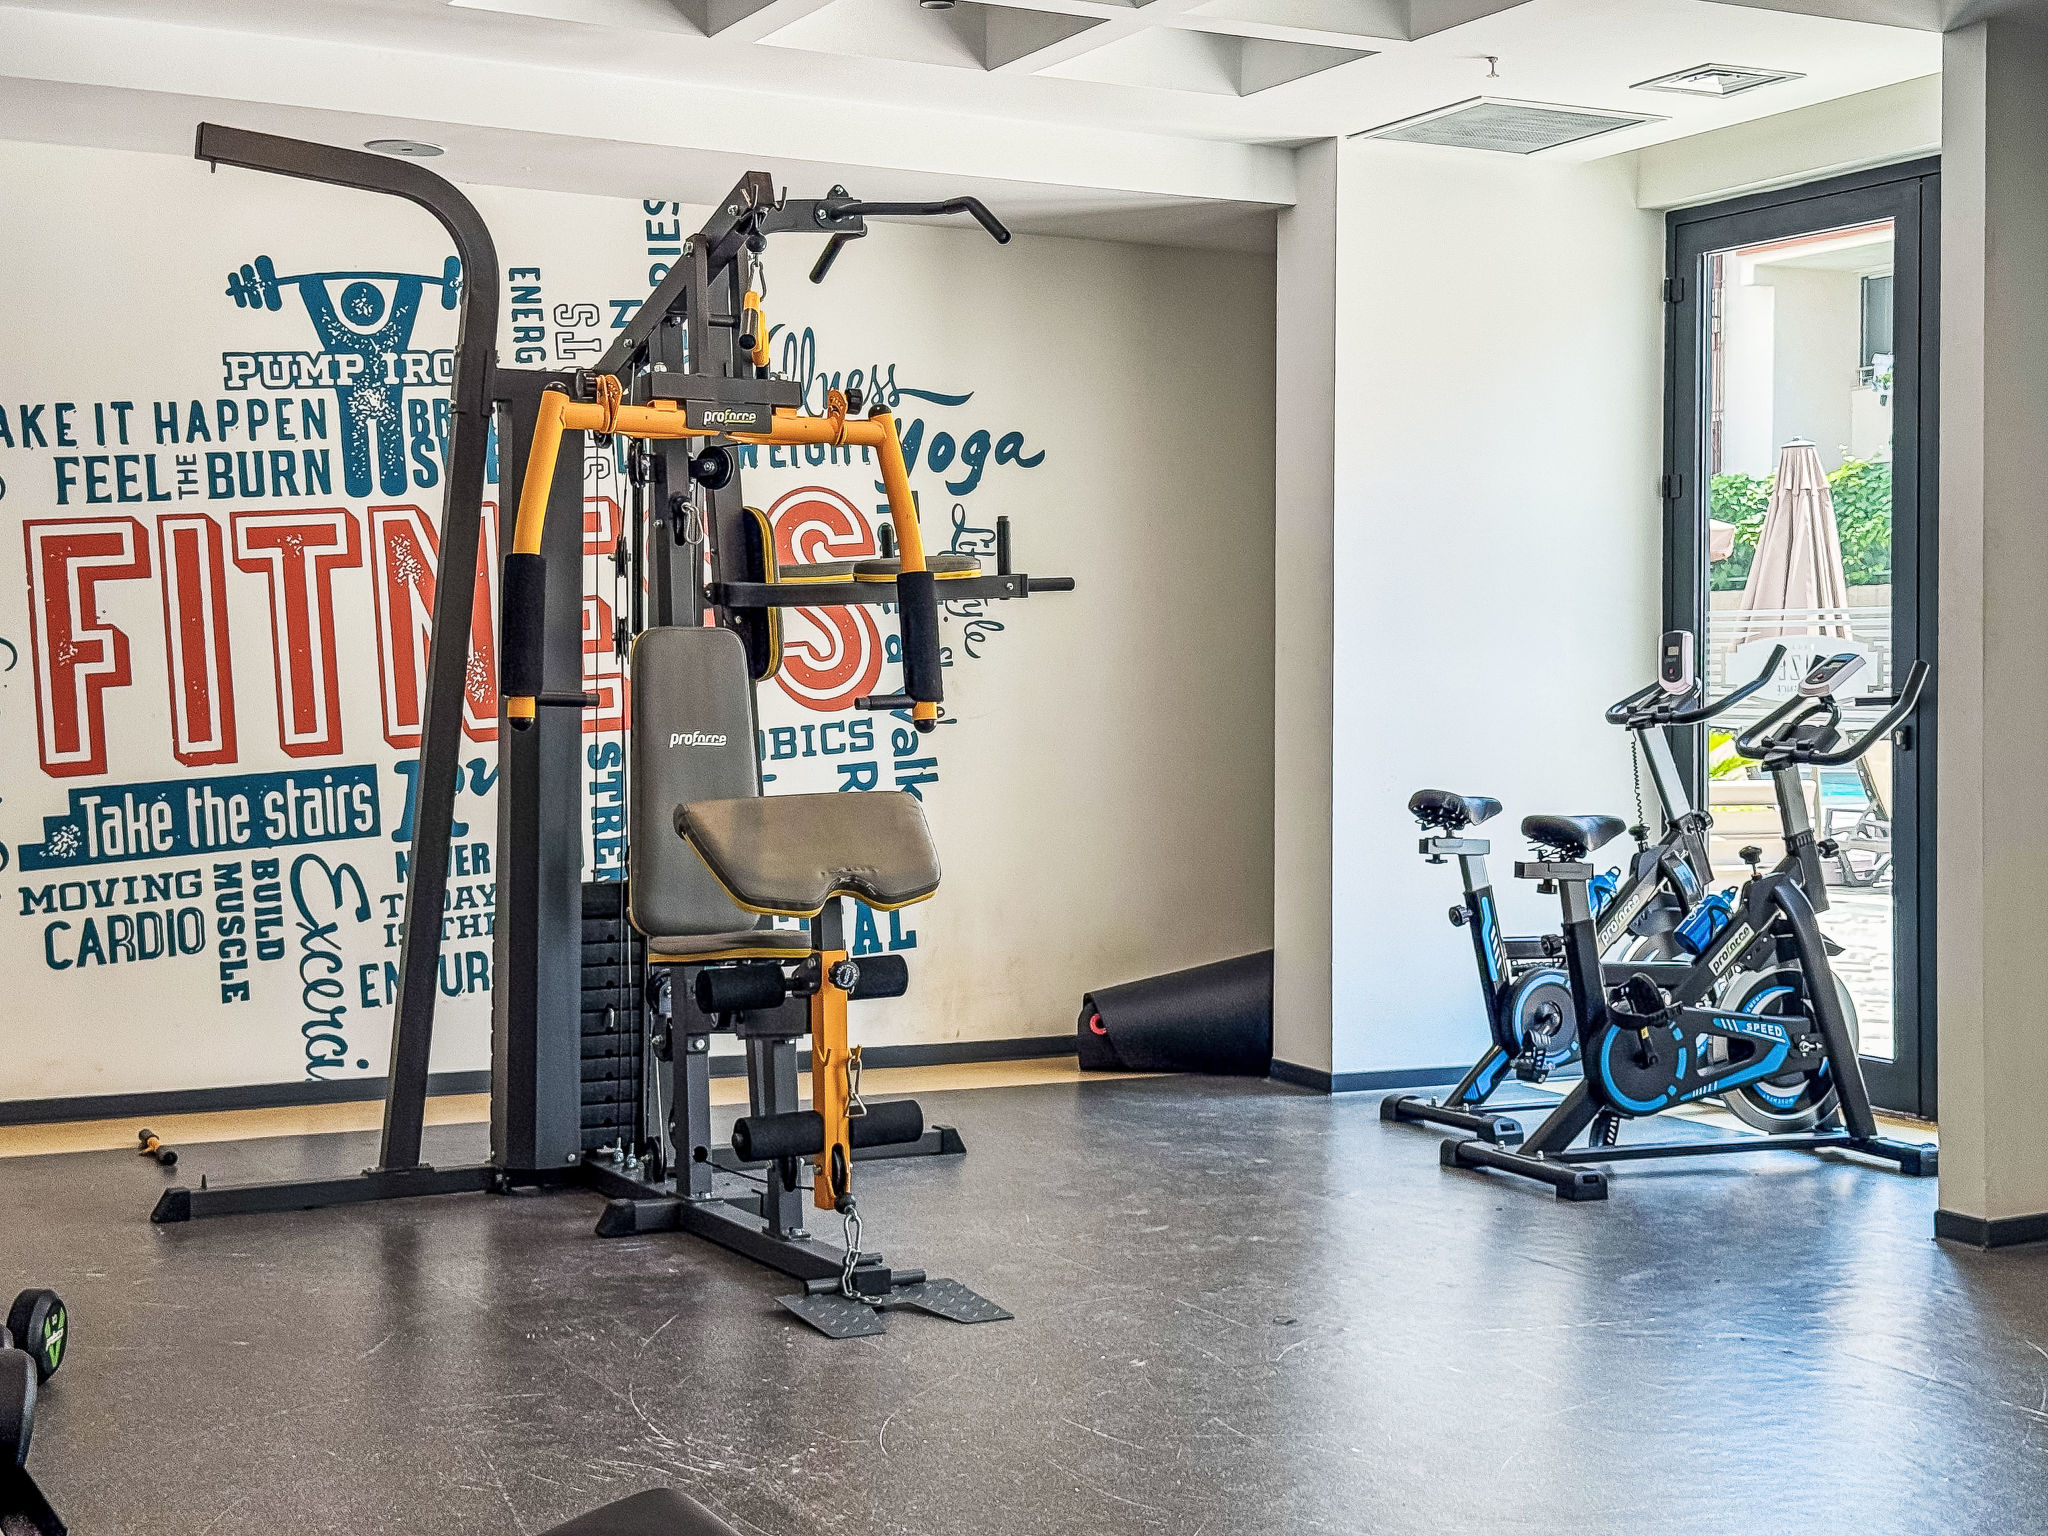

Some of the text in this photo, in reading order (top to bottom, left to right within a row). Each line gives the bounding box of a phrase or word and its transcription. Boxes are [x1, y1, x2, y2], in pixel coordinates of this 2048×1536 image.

[509, 267, 547, 364] ENERG
[223, 350, 454, 390] PUMP IRO
[94, 400, 135, 446] IT
[153, 397, 326, 444] HAPPEN
[703, 409, 757, 426] proforce
[53, 453, 172, 505] FEEL
[176, 453, 199, 500] THE
[205, 449, 332, 500] BURN
[669, 730, 727, 749] proforce
[80, 774, 374, 859] Take the stairs
[19, 869, 203, 917] MOVING
[252, 857, 286, 962] BUILD
[44, 907, 206, 971] CARDIO
[213, 860, 251, 1005] MUSCLE
[290, 852, 372, 1081] Excerci
[1745, 1021, 1783, 1038] SPEED
